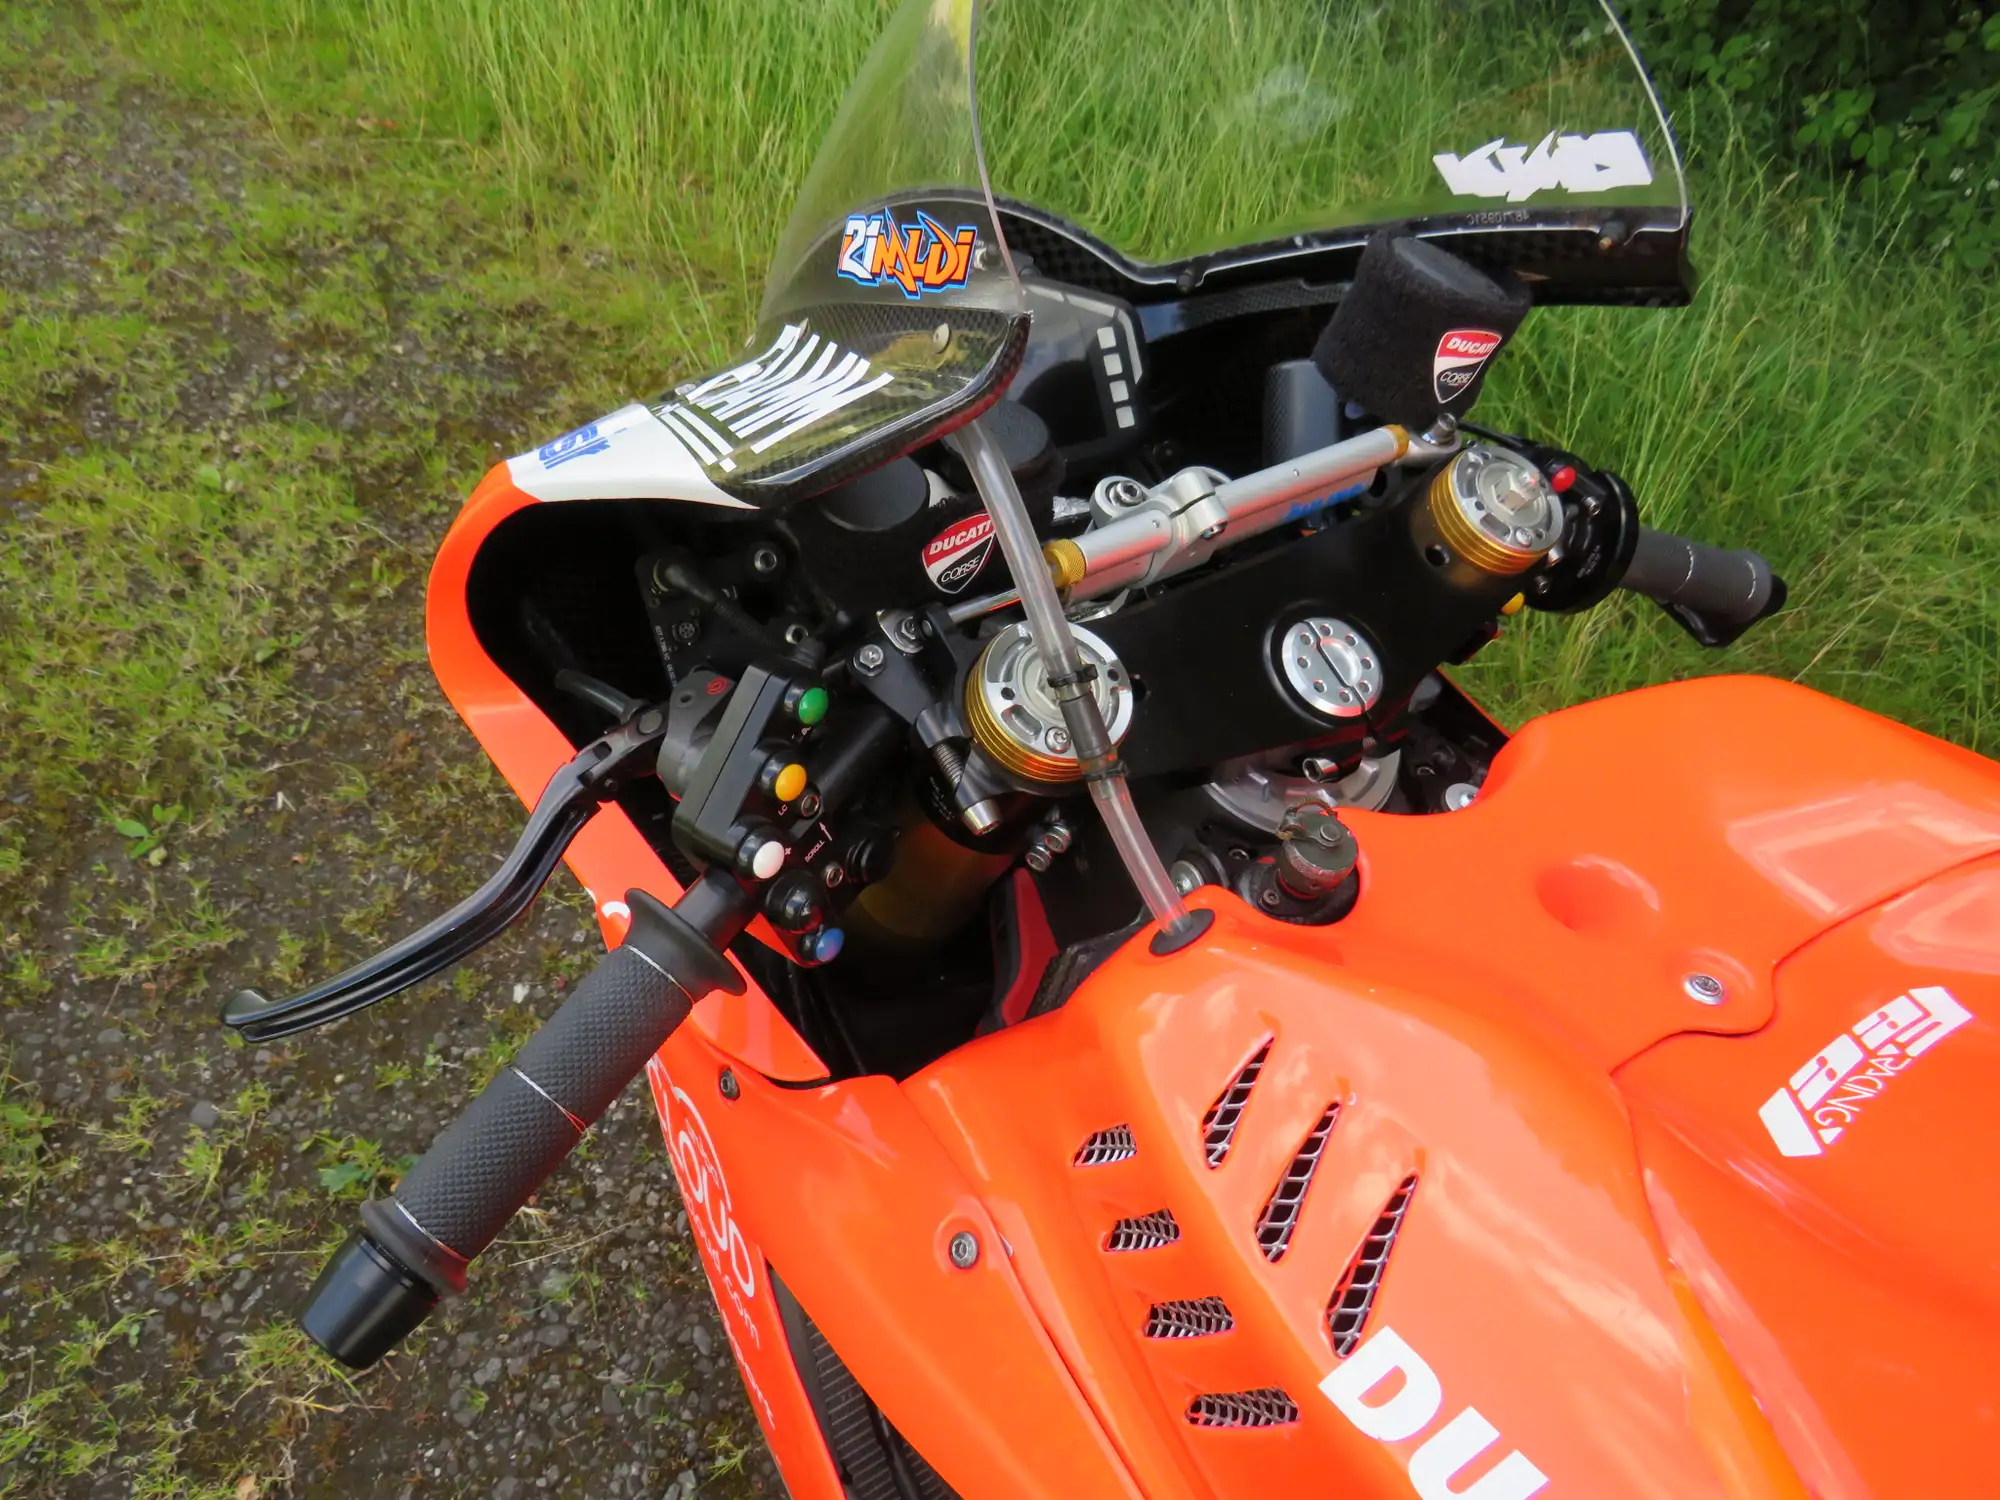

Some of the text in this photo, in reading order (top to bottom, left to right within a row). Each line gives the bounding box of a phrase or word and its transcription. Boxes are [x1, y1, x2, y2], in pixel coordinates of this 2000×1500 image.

[1446, 337, 1493, 355] DUCATI
[1440, 371, 1472, 384] CORSE
[929, 521, 993, 555] DUCATI
[941, 556, 980, 583] CORSE
[804, 840, 826, 864] SCROLL
[1813, 1056, 1912, 1127] RACING
